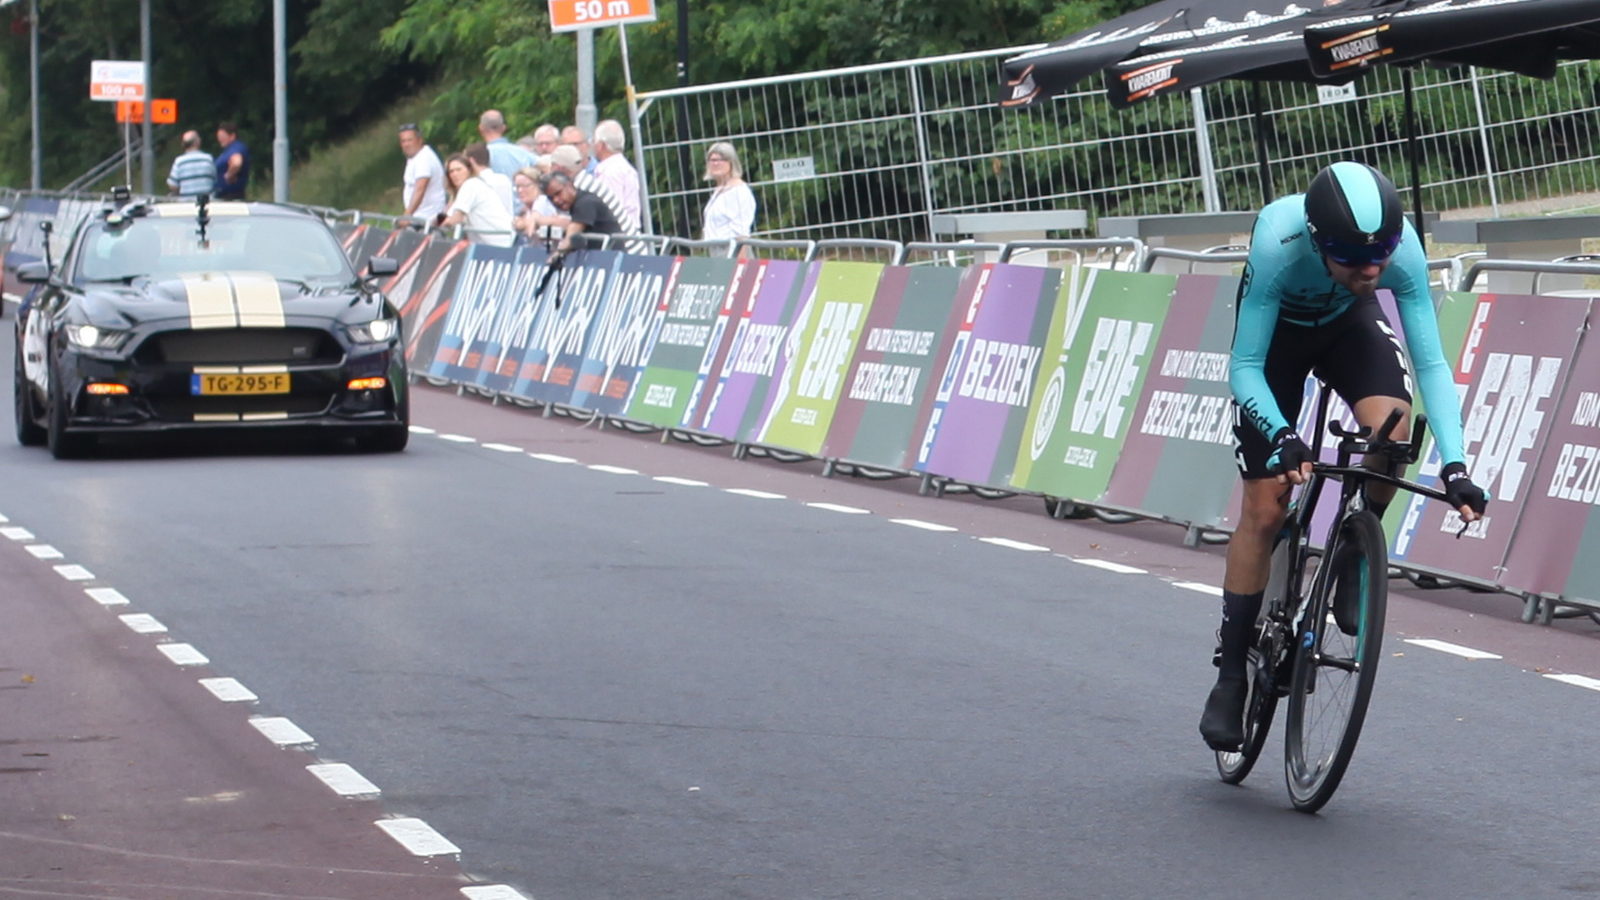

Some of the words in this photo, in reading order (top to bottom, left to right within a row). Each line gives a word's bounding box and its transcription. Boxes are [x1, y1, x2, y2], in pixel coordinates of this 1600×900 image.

[574, 1, 603, 21] 50
[607, 1, 630, 17] m
[101, 85, 121, 96] 100
[797, 301, 864, 400] EDE
[206, 375, 283, 392] TG-295-F
[959, 338, 1041, 407] BEZOEK
[1070, 316, 1154, 439] EDE
[1242, 396, 1273, 438] Hertz
[1463, 352, 1562, 502] EDE
[1571, 391, 1598, 428] KOM
